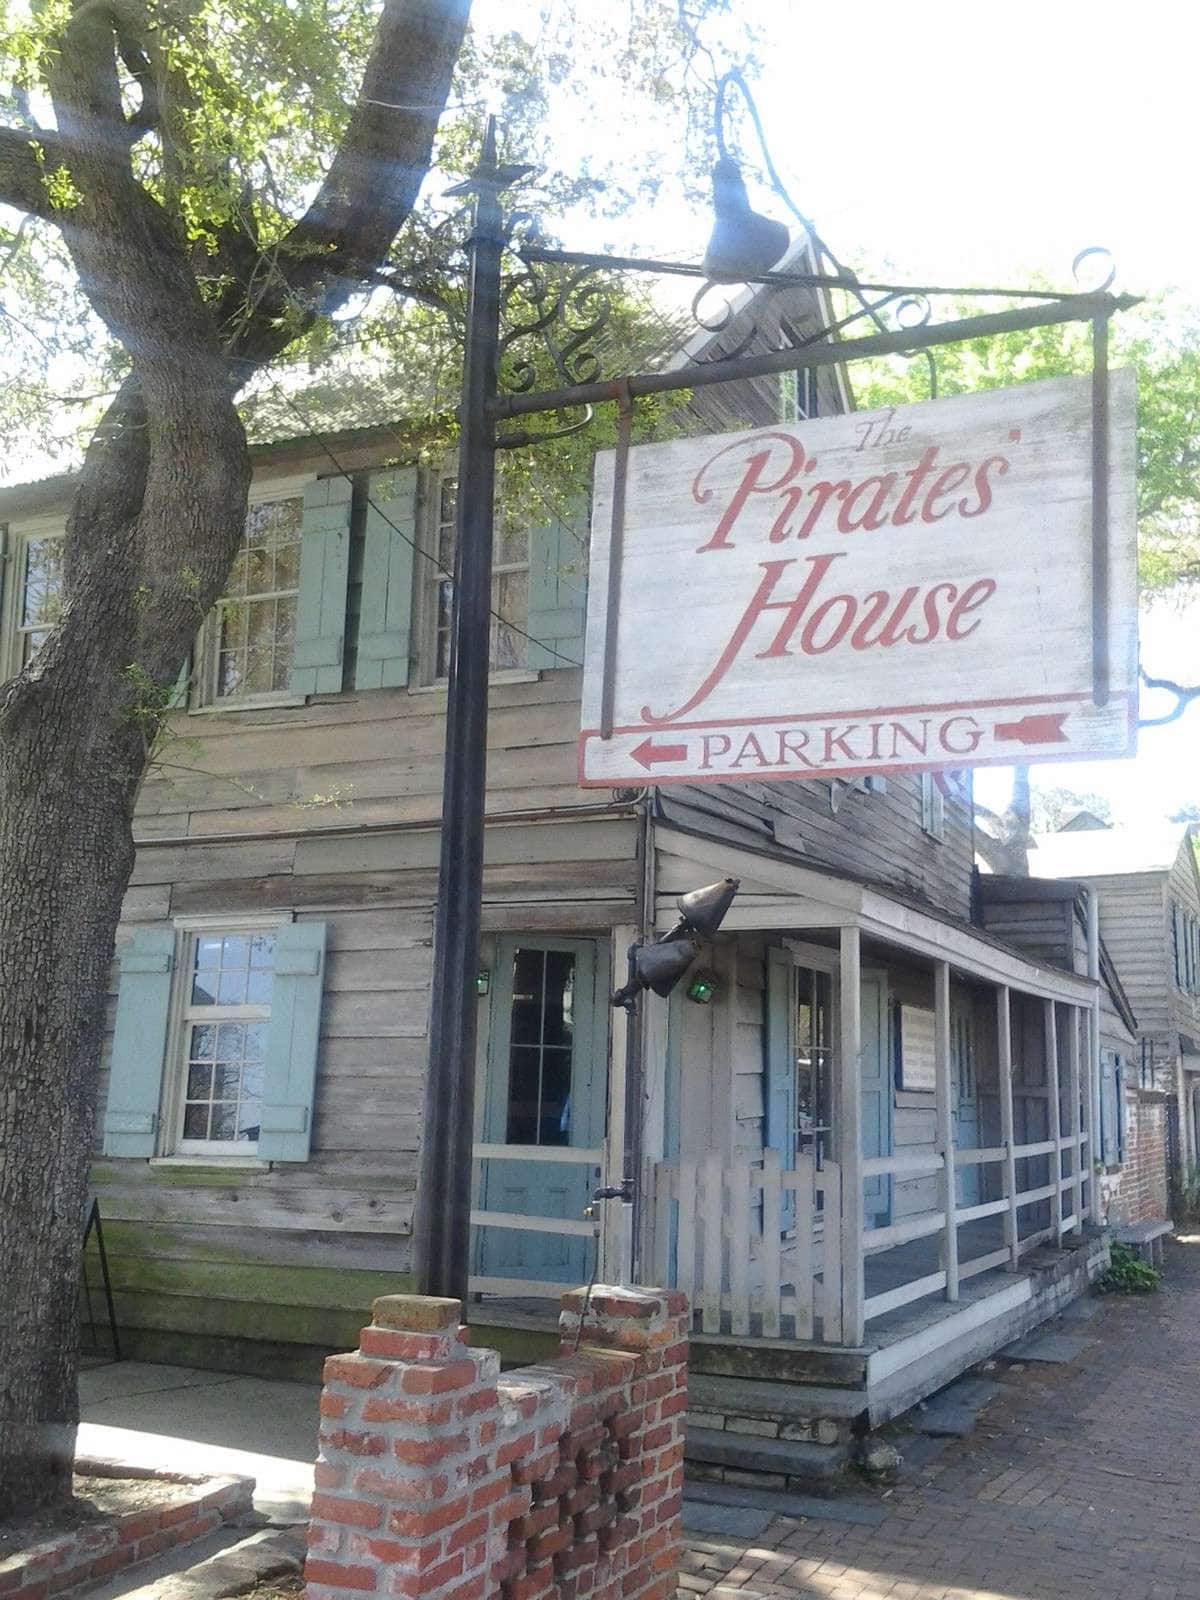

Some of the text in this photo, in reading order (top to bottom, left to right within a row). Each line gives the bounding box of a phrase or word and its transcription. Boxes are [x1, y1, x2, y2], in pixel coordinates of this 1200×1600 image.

[856, 408, 911, 452] The
[641, 553, 996, 723] House
[699, 716, 985, 770] PARKING
